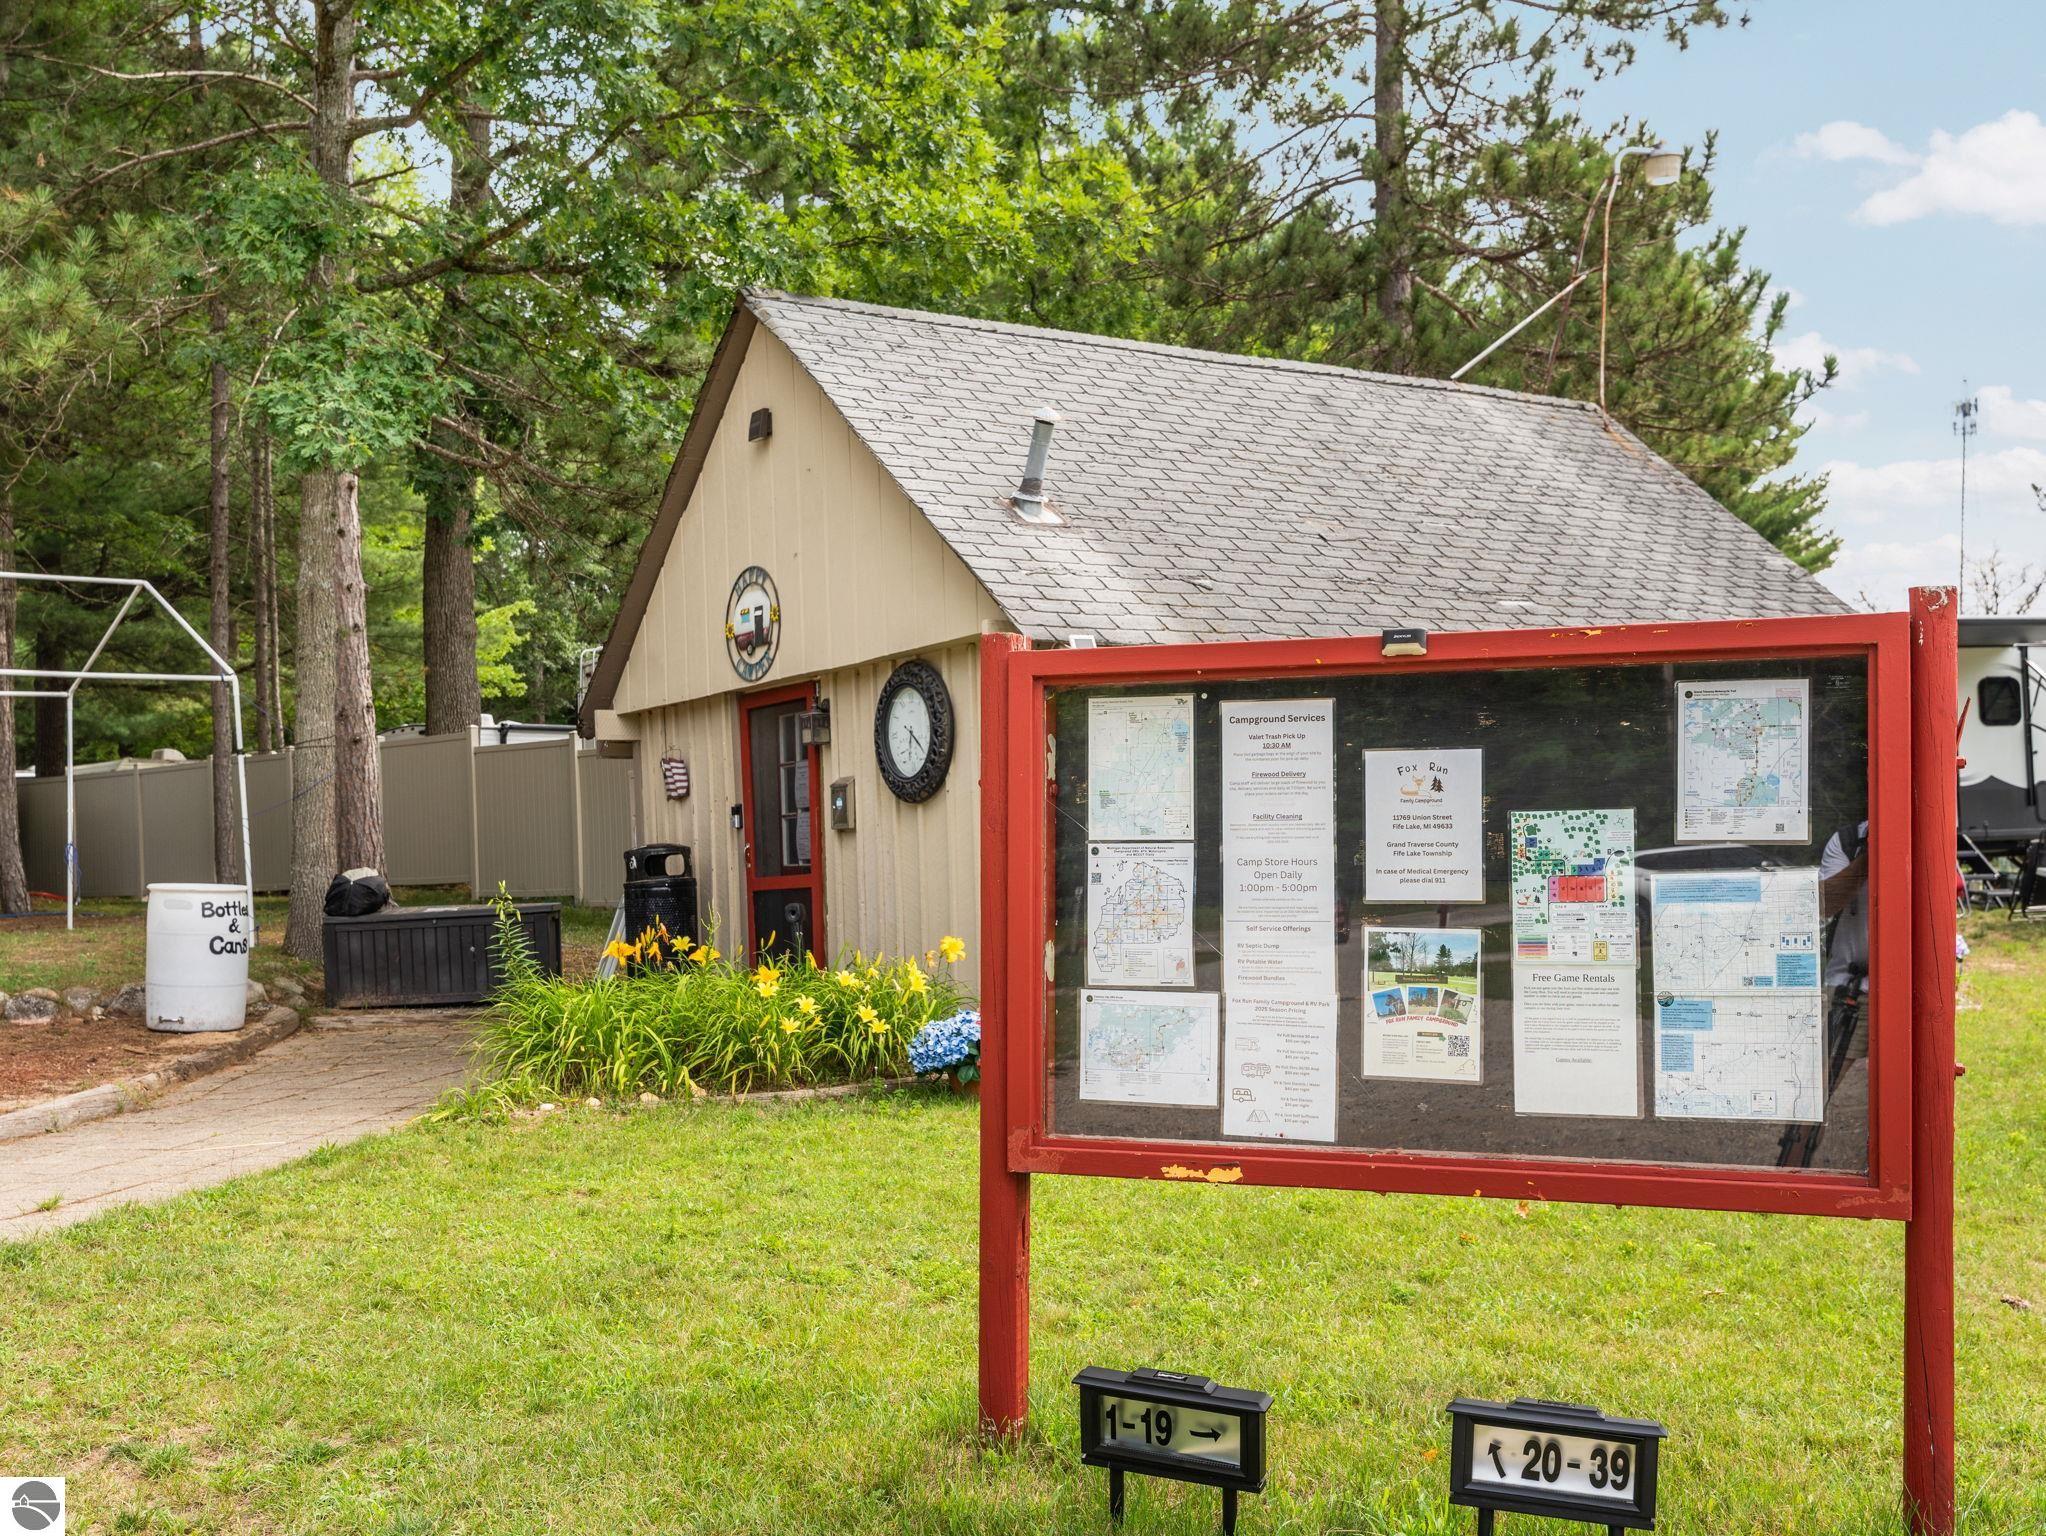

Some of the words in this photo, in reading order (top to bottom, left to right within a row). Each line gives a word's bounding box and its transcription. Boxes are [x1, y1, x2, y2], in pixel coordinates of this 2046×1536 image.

[1229, 714, 1286, 725] Campground
[1288, 714, 1325, 722] Services
[1397, 764, 1418, 776] Fox
[1429, 761, 1449, 775] Run
[1237, 858, 1263, 868] Camp
[1254, 871, 1278, 880] Open
[1280, 871, 1302, 880] Daily
[1240, 884, 1274, 893] 1:00pm
[1282, 884, 1317, 893] 5:00pm
[229, 918, 241, 933] &
[209, 936, 247, 955] Cans
[1532, 973, 1551, 982] Free
[1554, 974, 1580, 982] Game
[1582, 974, 1615, 982] Rentals
[1426, 1016, 1459, 1028] CAMPGROUND
